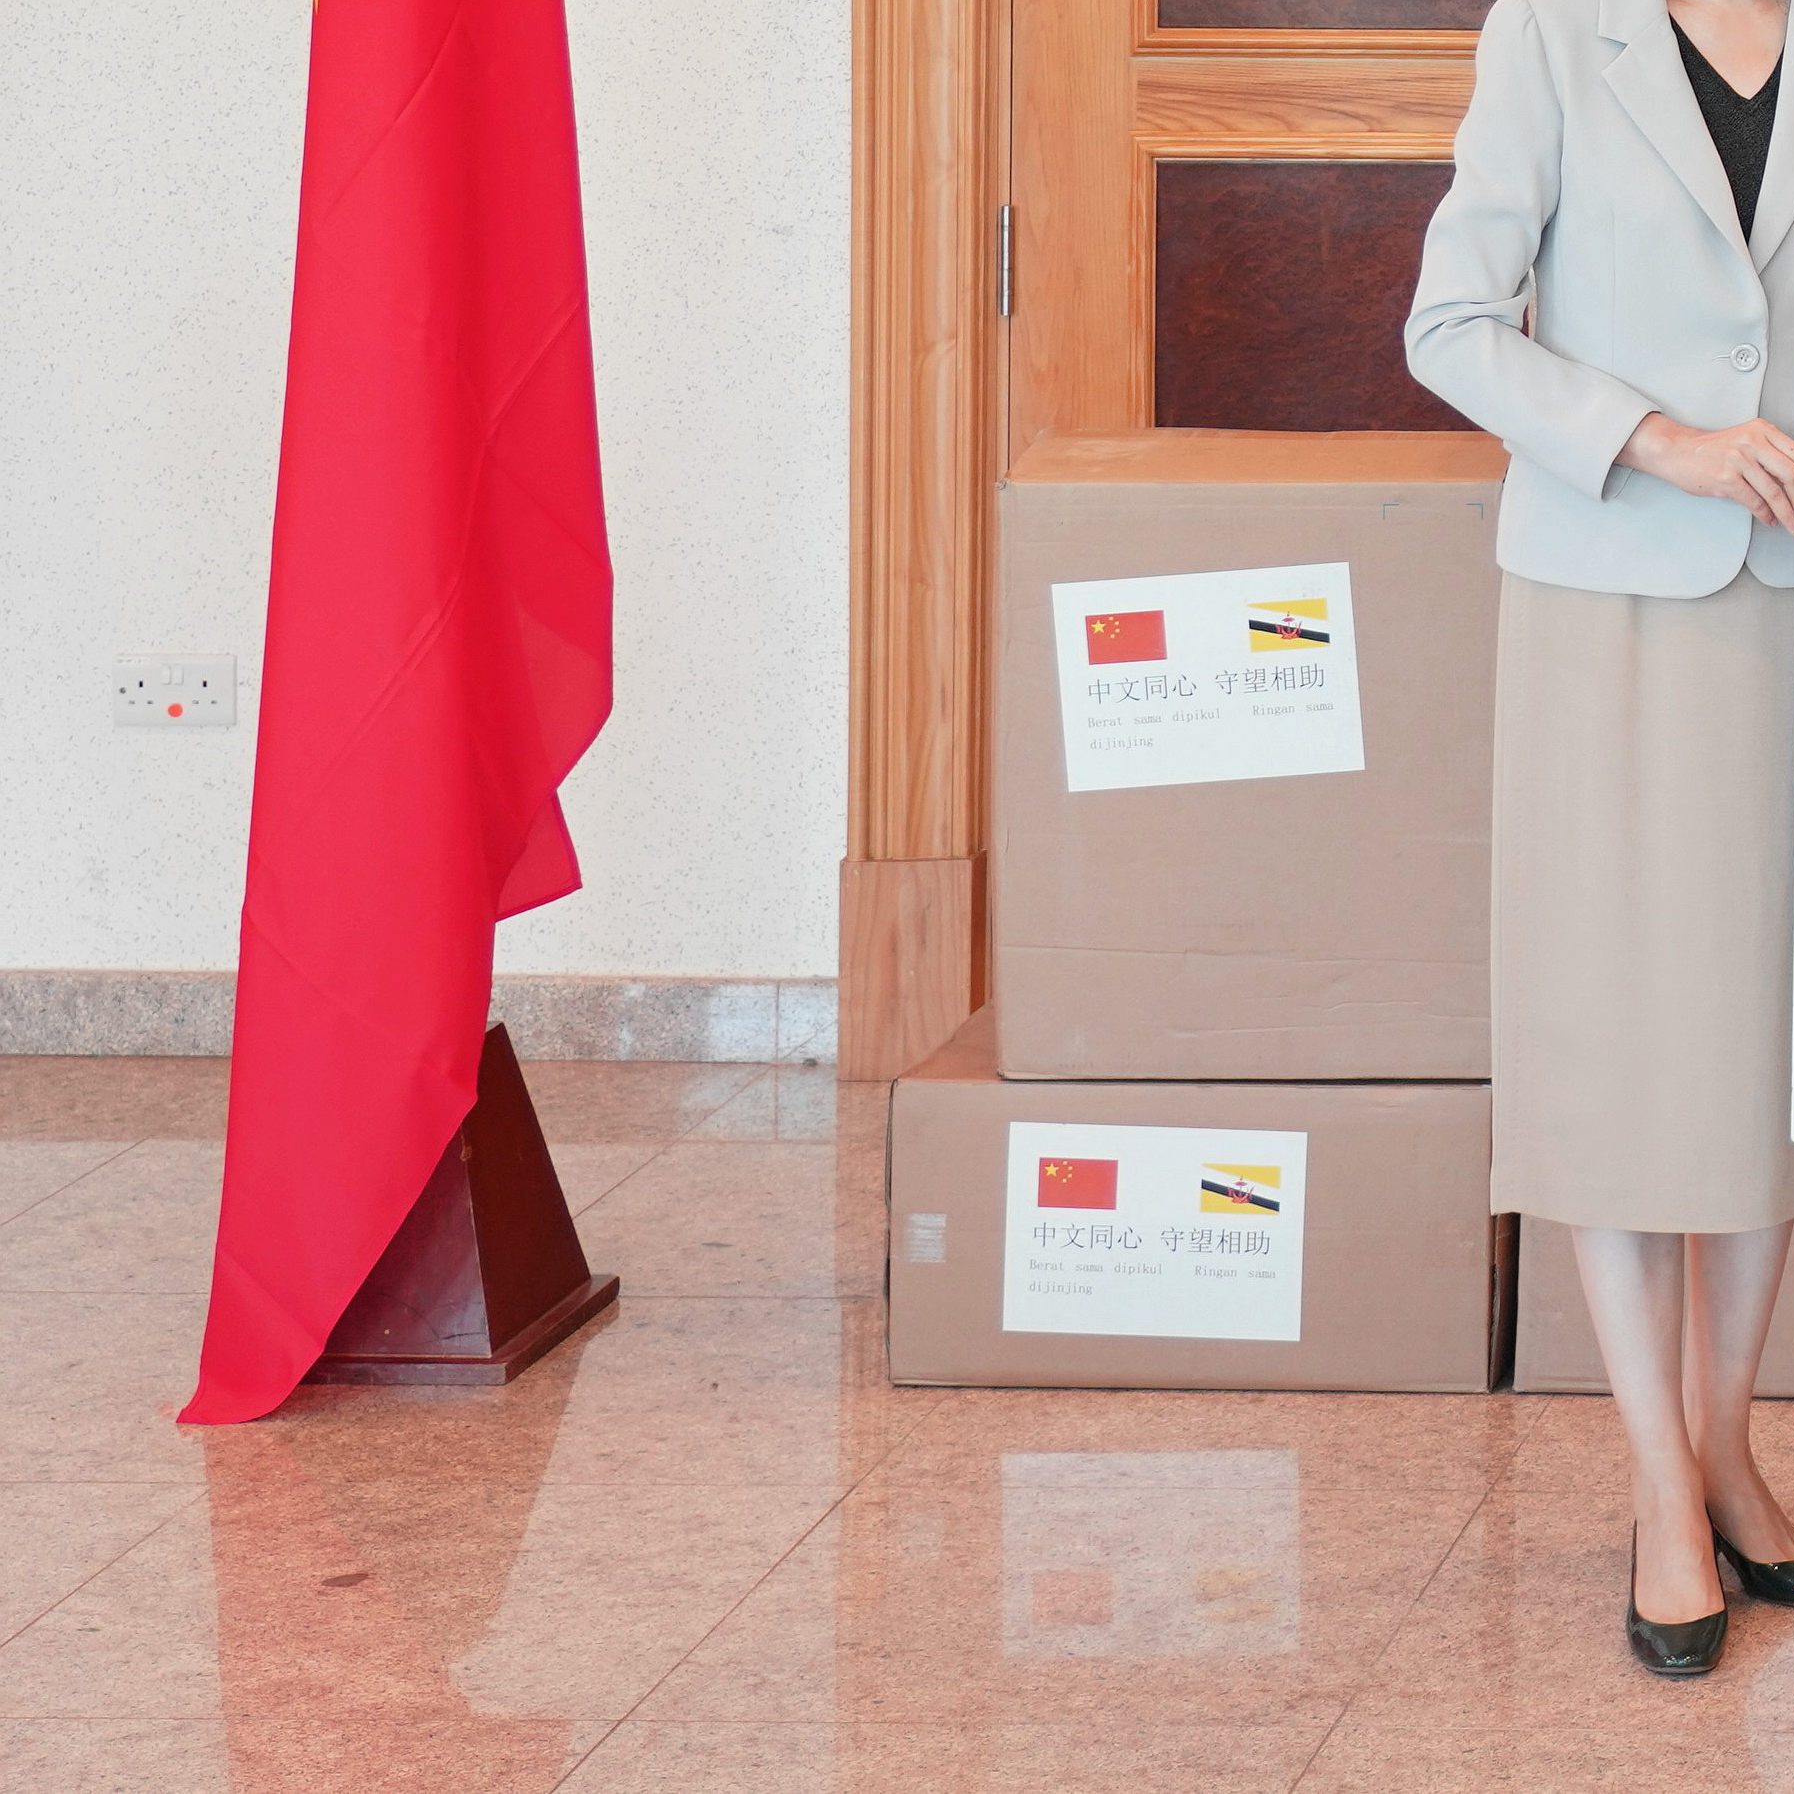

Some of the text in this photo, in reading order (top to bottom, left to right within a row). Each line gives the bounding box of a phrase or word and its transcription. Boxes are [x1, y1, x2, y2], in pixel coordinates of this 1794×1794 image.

[1088, 663, 1324, 705] 中文同心 守望相助
[1087, 702, 1336, 729] Berat sama dipikul Ringan sama
[1089, 735, 1154, 752] dijinjing
[1034, 1222, 1270, 1255] 中文同心 守望相助
[1028, 1258, 1277, 1280] Berat sama dipikul Ringan sama
[1028, 1280, 1094, 1297] dijinjing
